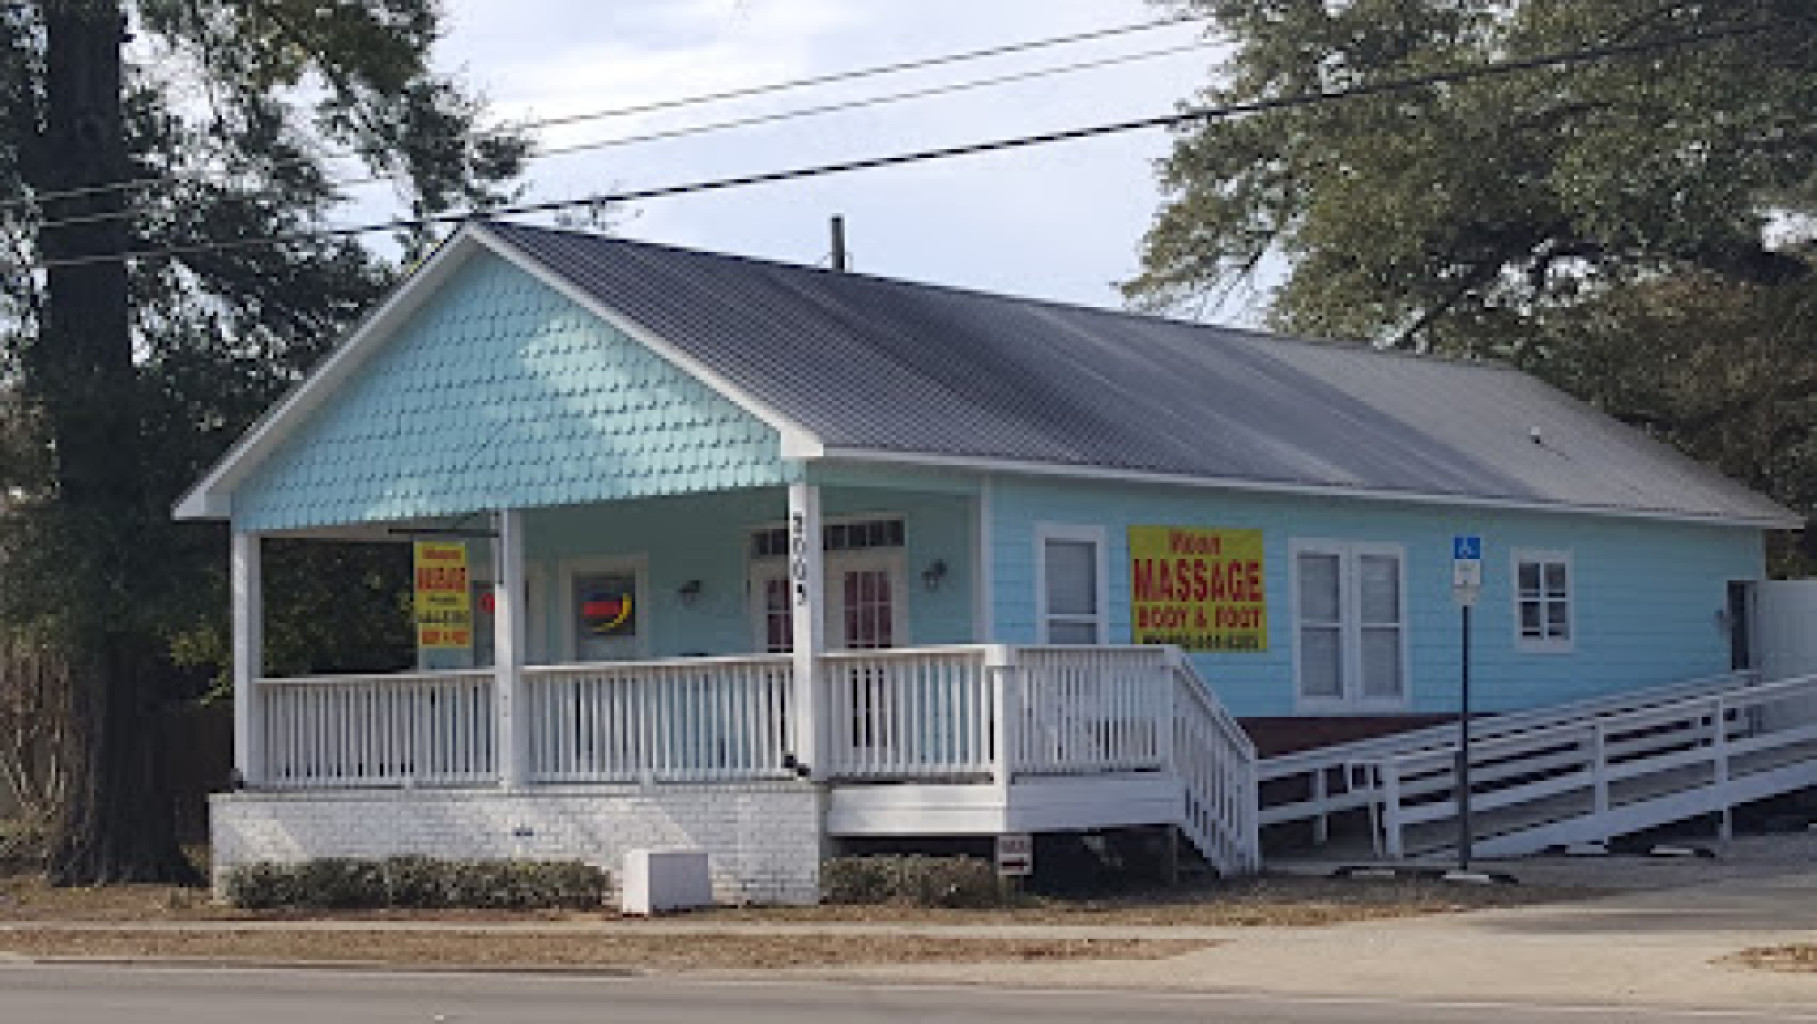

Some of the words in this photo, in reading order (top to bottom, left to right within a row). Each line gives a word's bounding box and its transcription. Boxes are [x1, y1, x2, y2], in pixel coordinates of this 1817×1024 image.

[1133, 558, 1263, 602] MASSAGE
[1138, 606, 1187, 628] BODY
[1194, 605, 1208, 628] &
[1215, 606, 1261, 628] FOOT
